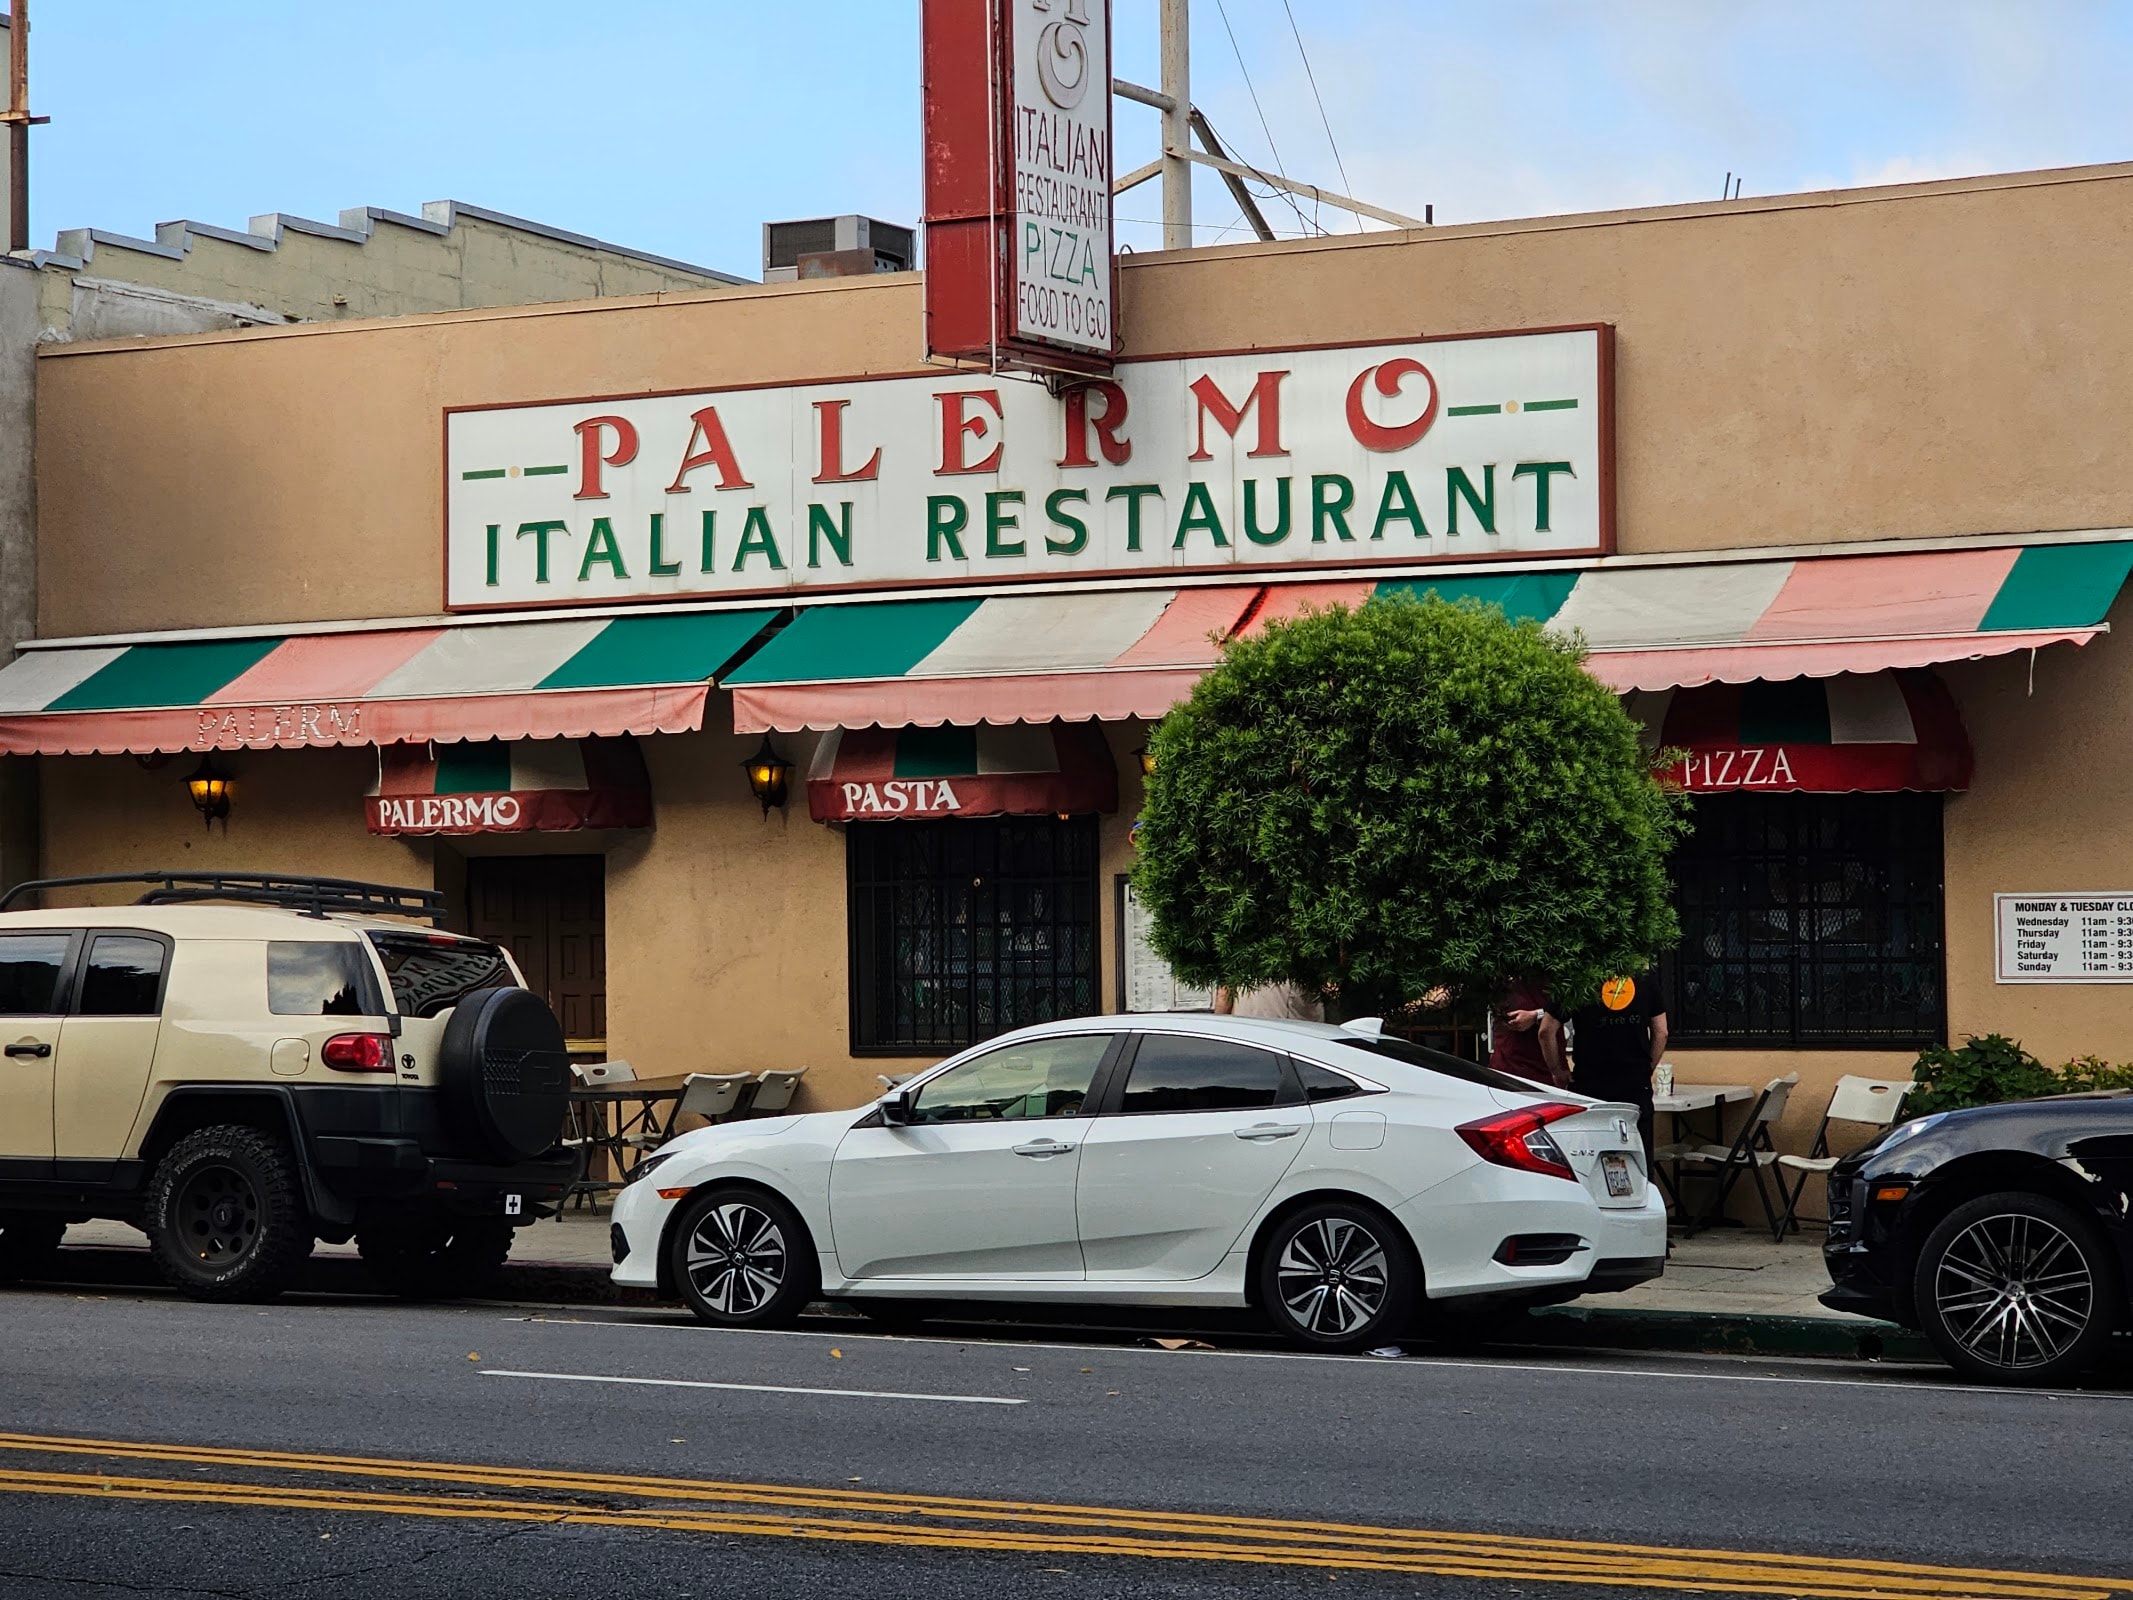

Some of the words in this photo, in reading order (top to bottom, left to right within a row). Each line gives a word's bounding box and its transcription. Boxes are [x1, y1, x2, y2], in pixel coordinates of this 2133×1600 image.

[1016, 105, 1105, 183] ITALIAN
[1017, 171, 1105, 232] RESTAURANT
[1026, 222, 1099, 290] PIZZA
[1019, 281, 1059, 329] FOOD
[1062, 291, 1081, 336] TO
[1085, 296, 1107, 341] GO
[573, 357, 1439, 501] PALERMO
[486, 501, 854, 587] ITALIAN
[926, 460, 1578, 562] RESTAURANT
[196, 704, 361, 746] PALERM
[1684, 747, 1798, 787] PIZZA
[378, 796, 521, 828] PALERMO
[842, 779, 962, 813] PASTA
[2015, 902, 2057, 912] MONDAY
[2060, 902, 2068, 911] &
[2070, 902, 2114, 912] TUESDAY
[2017, 917, 2069, 927] Wednesday
[2082, 917, 2107, 925] 11am
[2117, 917, 2133, 925] 9:3
[2017, 928, 2059, 939] Thursday
[2082, 928, 2107, 937] 11am
[2117, 928, 2133, 937] 9:3
[2017, 940, 2046, 950] Friday
[2082, 940, 2107, 948] 11am
[2017, 951, 2059, 961] Saturday
[2082, 951, 2107, 959] 11am
[2017, 962, 2051, 972] Sunday
[2082, 962, 2107, 971] 11am
